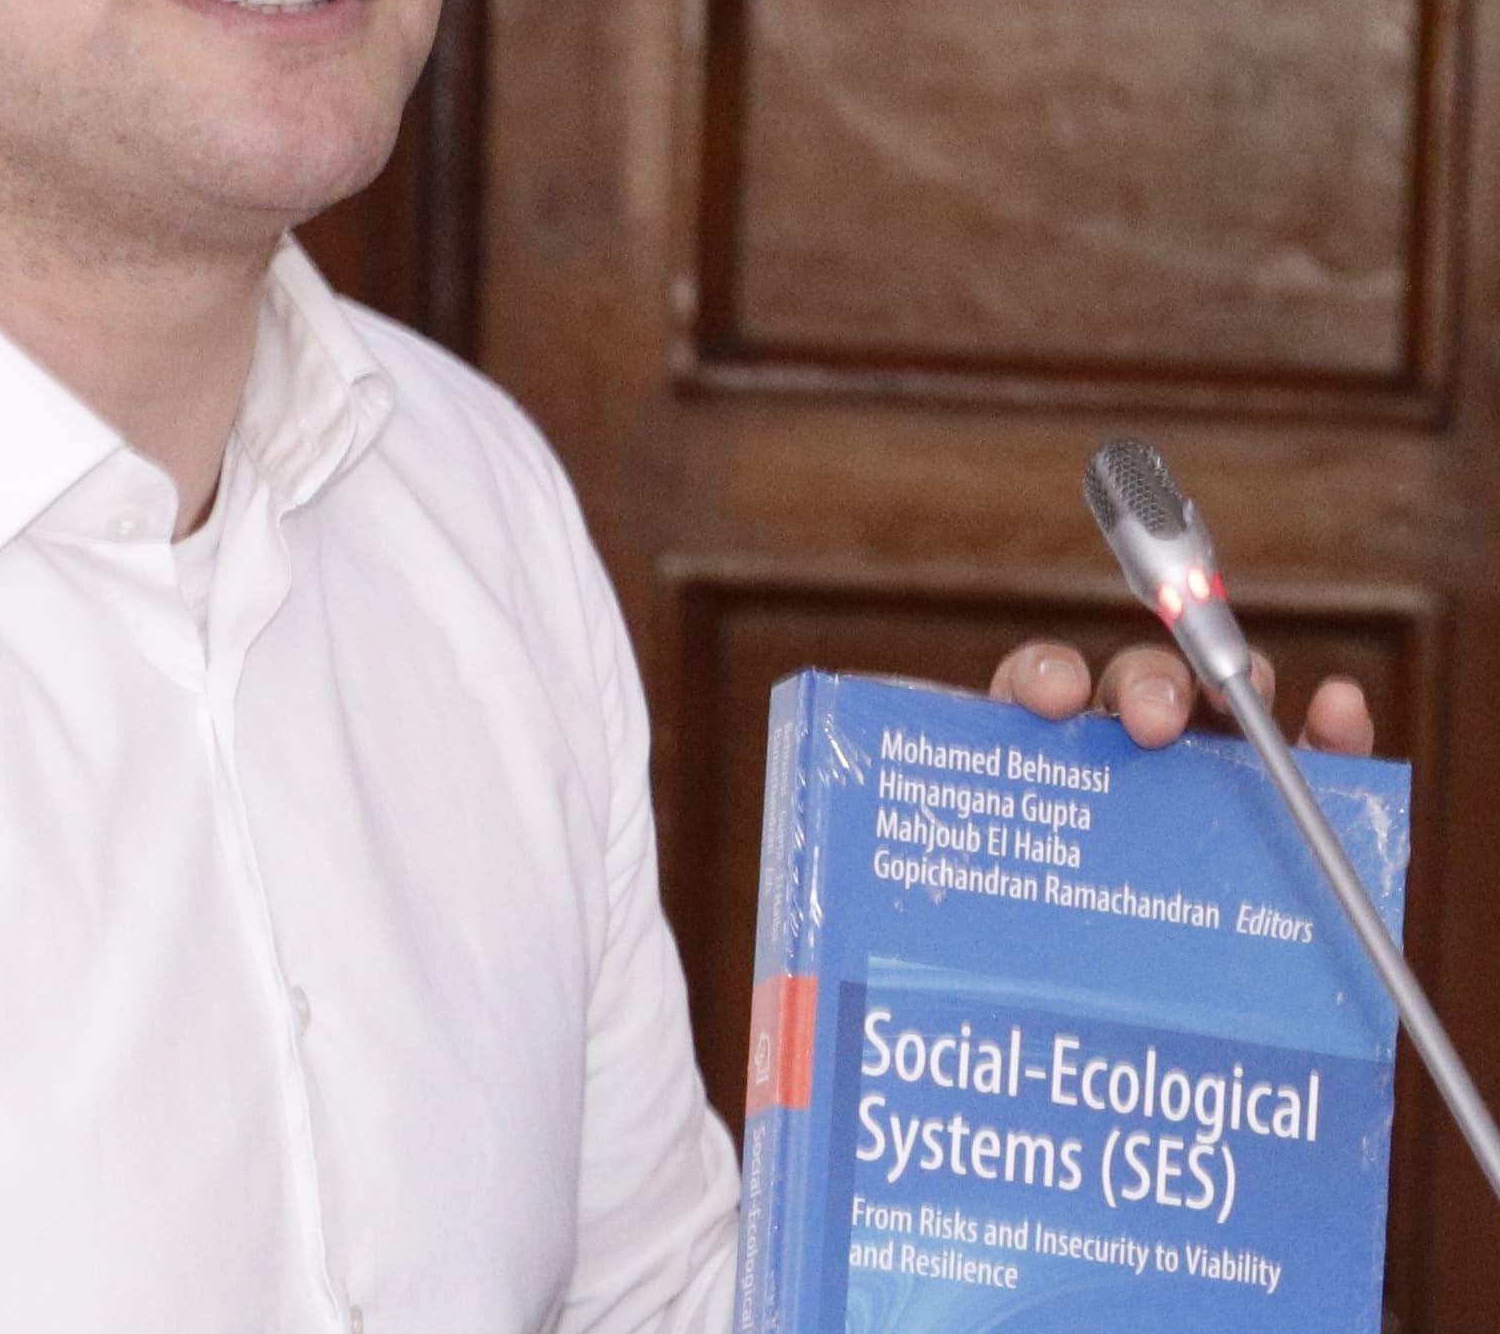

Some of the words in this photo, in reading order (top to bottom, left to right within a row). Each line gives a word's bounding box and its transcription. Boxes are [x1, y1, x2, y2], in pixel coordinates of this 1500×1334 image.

[879, 769, 1014, 819] Himangana
[1021, 791, 1092, 832] Gupta
[881, 730, 1001, 777] Mohamed
[1007, 748, 1110, 794] Behnassi
[876, 808, 981, 854] Mahjoub
[987, 826, 1008, 857] El
[1014, 829, 1081, 868] Haiba
[873, 848, 1038, 902] Gopichandran
[1044, 874, 1220, 929] Ramachandran
[1236, 903, 1315, 944] Editors
[860, 1010, 1320, 1144] Social-Ecological
[855, 1094, 1083, 1191] Systems
[1101, 1129, 1236, 1224] (SES)
[848, 1240, 894, 1271] and
[900, 1244, 1019, 1289] Resilience
[851, 1196, 913, 1234] From
[919, 1206, 978, 1243] Risks
[983, 1220, 1029, 1251] and
[1035, 1222, 1150, 1275] Insecurity
[1155, 1243, 1179, 1273] to
[1185, 1244, 1282, 1294] Viability
